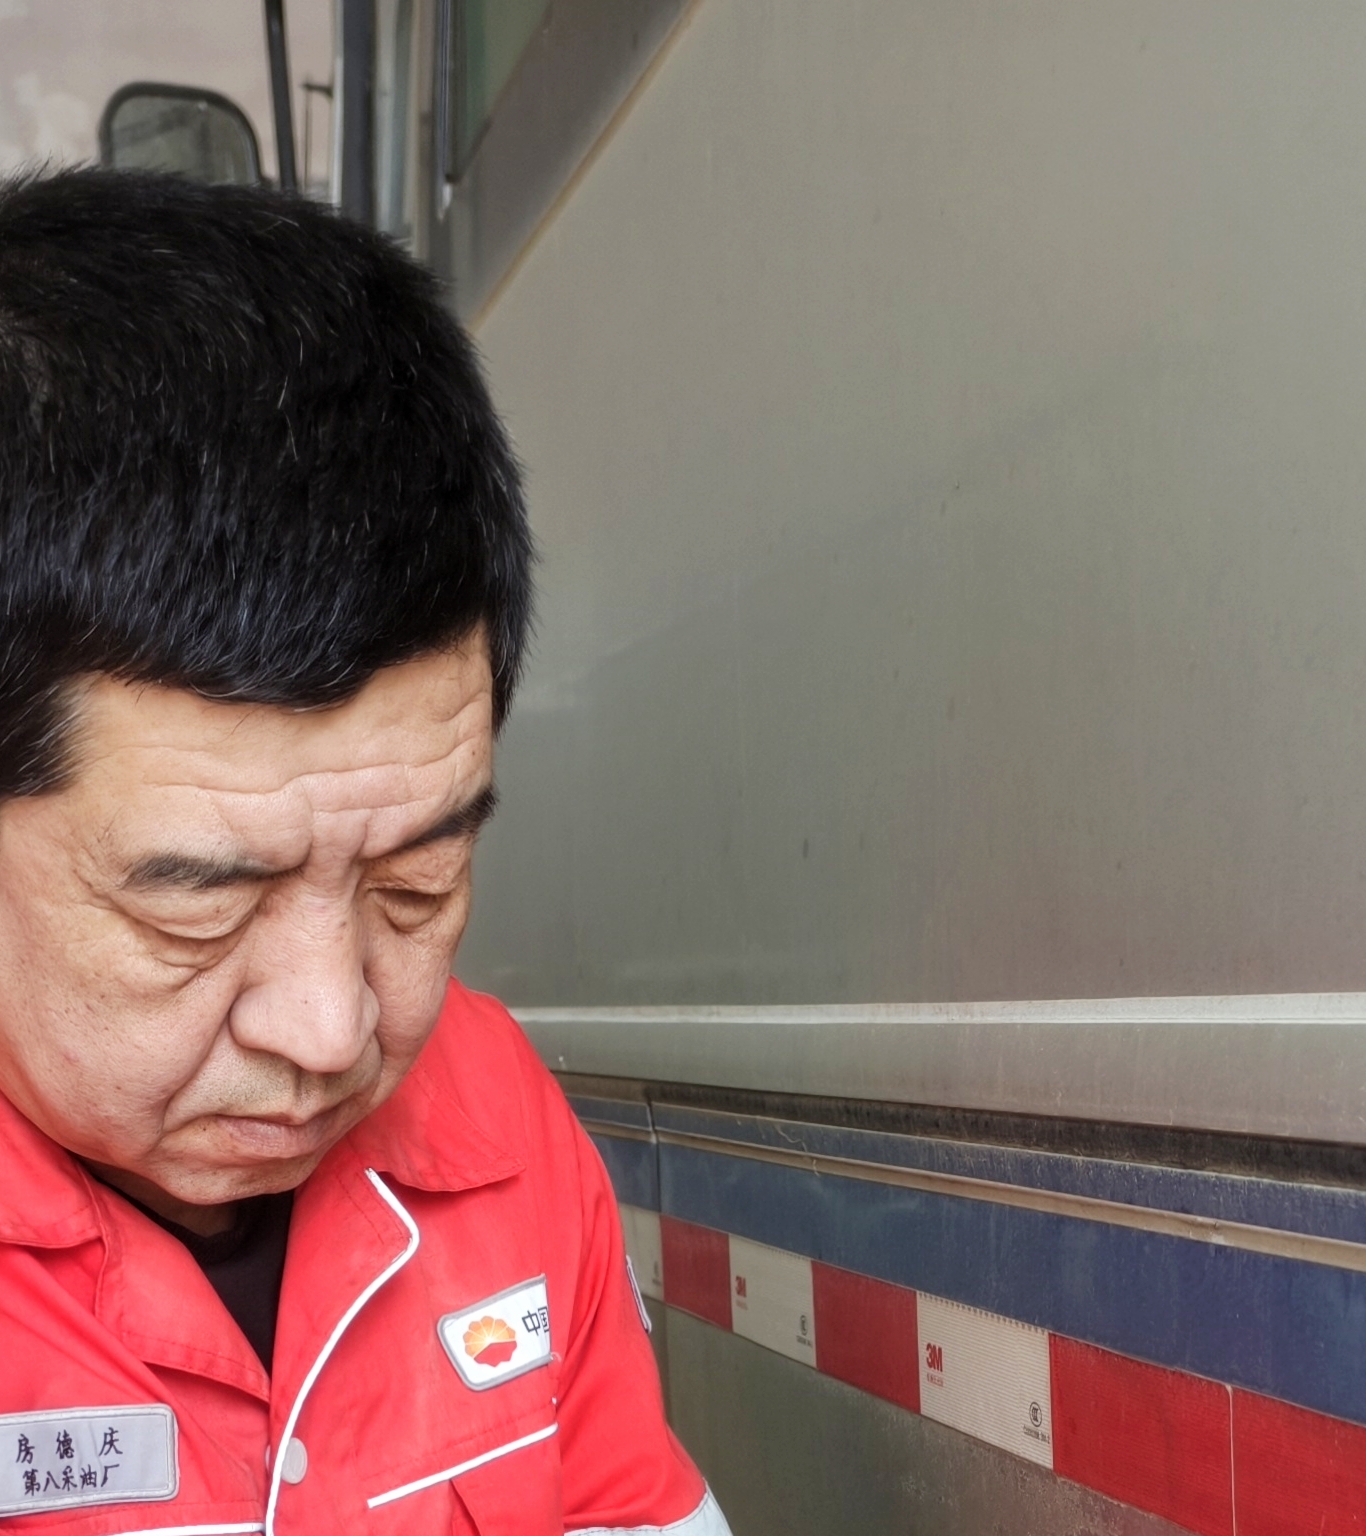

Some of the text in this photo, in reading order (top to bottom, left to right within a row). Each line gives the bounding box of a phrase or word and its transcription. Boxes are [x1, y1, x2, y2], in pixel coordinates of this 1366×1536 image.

[926, 1343, 943, 1372] 3M
[23, 1464, 120, 1496] 第八采油厂
